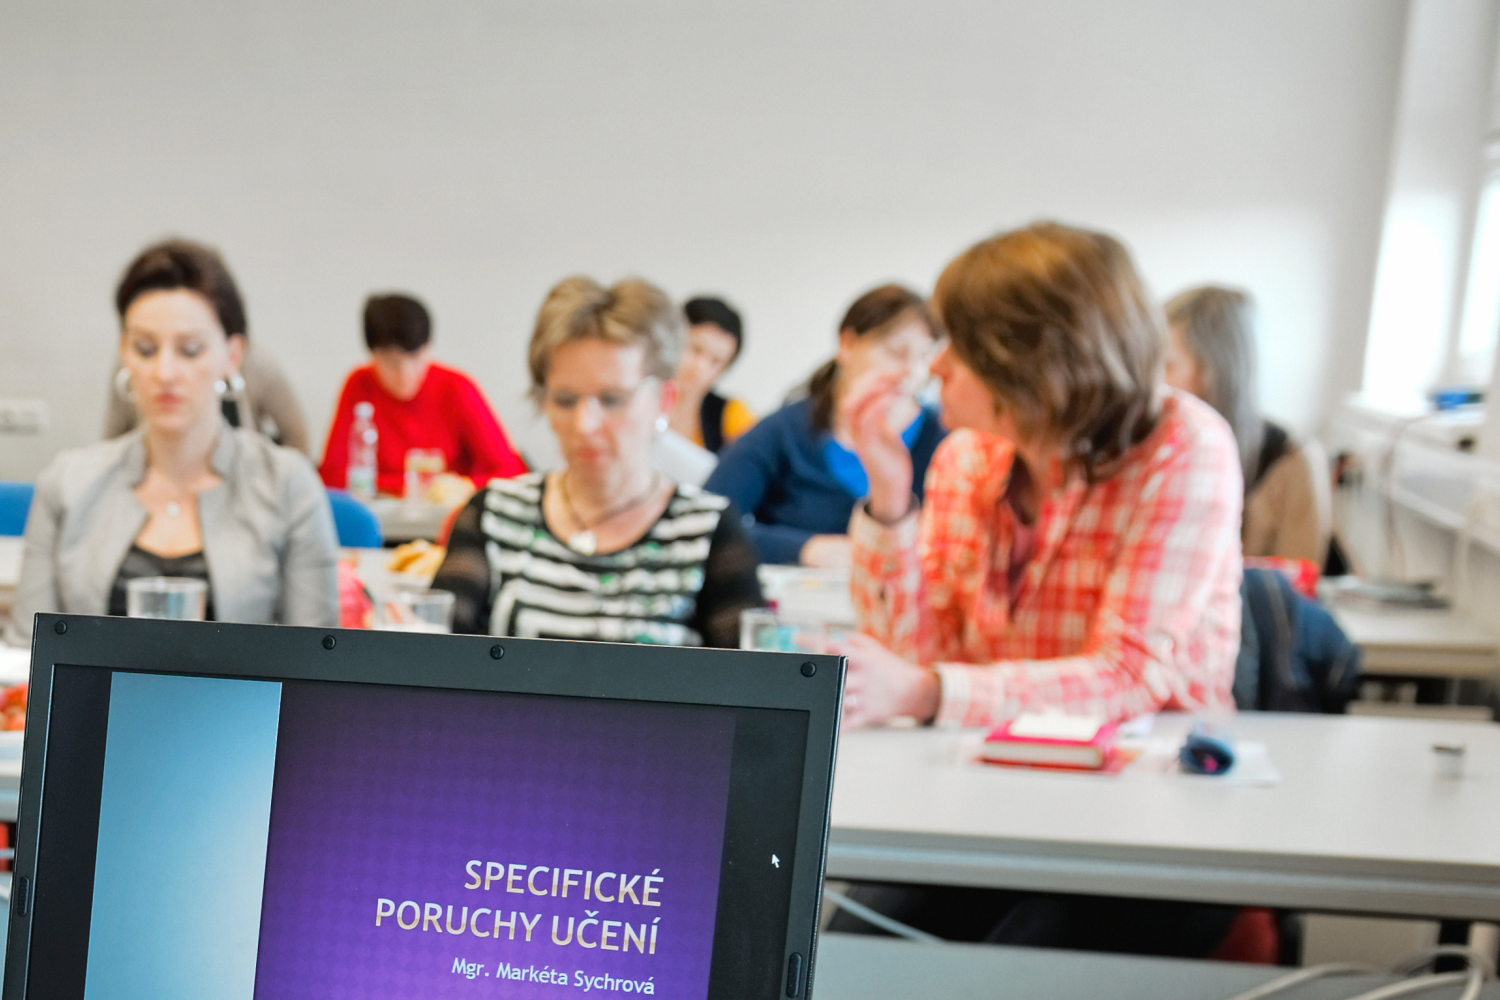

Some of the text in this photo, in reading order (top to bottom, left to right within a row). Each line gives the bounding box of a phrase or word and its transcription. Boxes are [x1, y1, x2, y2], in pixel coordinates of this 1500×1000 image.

[463, 859, 665, 907] SPECIFICKÉ
[375, 898, 661, 955] PORUCHY UČENÍ
[451, 957, 655, 995] Mgr. Markéta Sychrová
